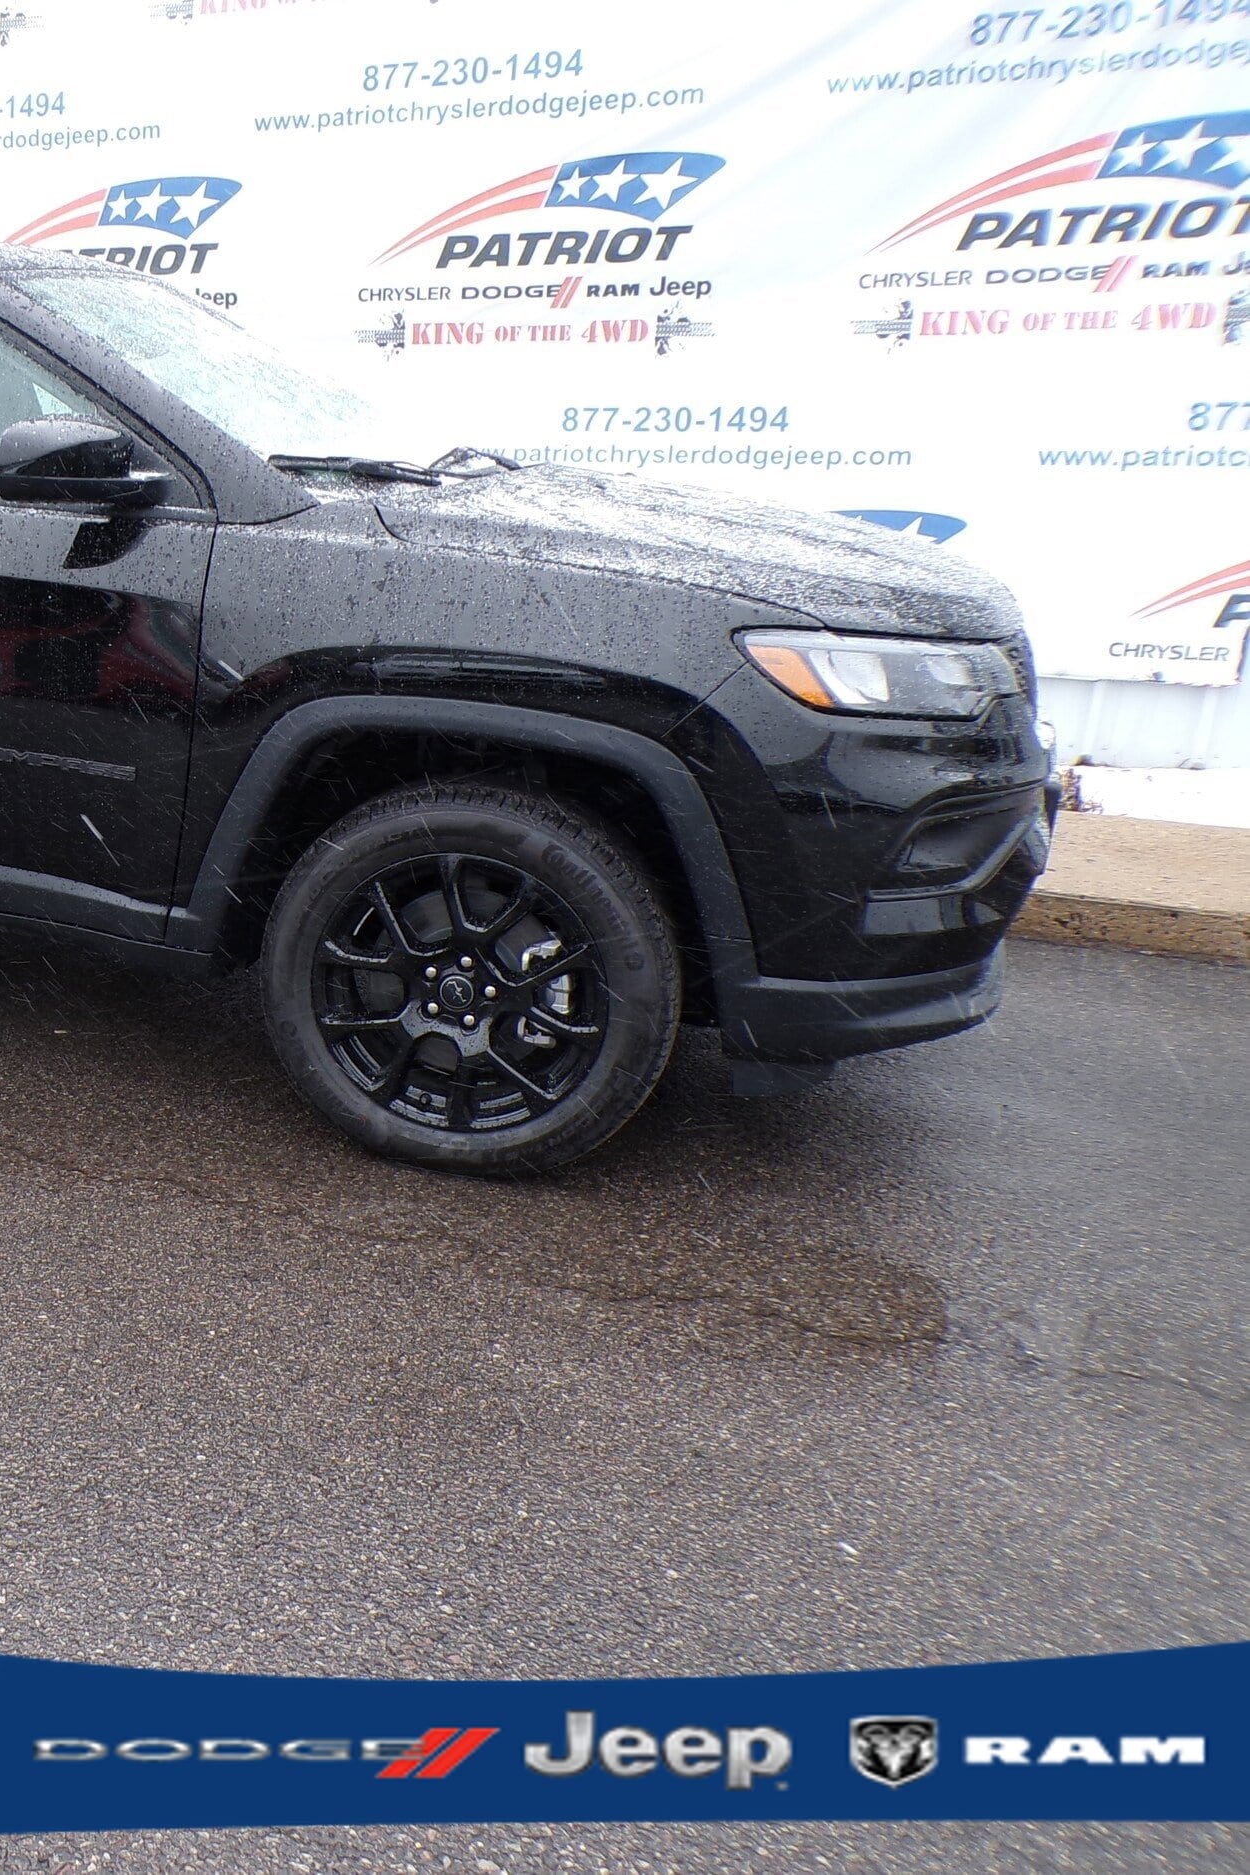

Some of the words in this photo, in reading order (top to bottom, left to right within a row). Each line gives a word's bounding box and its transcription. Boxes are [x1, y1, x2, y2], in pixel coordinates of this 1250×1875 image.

[362, 48, 584, 92] 877-230-1494
[254, 86, 705, 132] www.patriotchryslerdodgejeep.com
[435, 225, 694, 269] PATRIOT
[357, 286, 451, 303] CHRYSLER
[461, 284, 560, 300] DODGE
[586, 283, 640, 298] RAM
[649, 275, 712, 299] Jeep
[858, 270, 973, 289] CHRYSLER
[985, 264, 1112, 285] DODGE
[1140, 261, 1210, 279] RAM
[411, 321, 484, 346] KING
[494, 325, 521, 342] OF
[527, 324, 571, 342] THE
[581, 319, 649, 344] 4WD
[918, 308, 1011, 336] KING
[1022, 312, 1057, 332] OF
[1064, 309, 1118, 330] THE
[1130, 302, 1217, 330] 4WD
[561, 405, 791, 433] 877-230-1494
[1108, 642, 1230, 661] CHRYSLER
